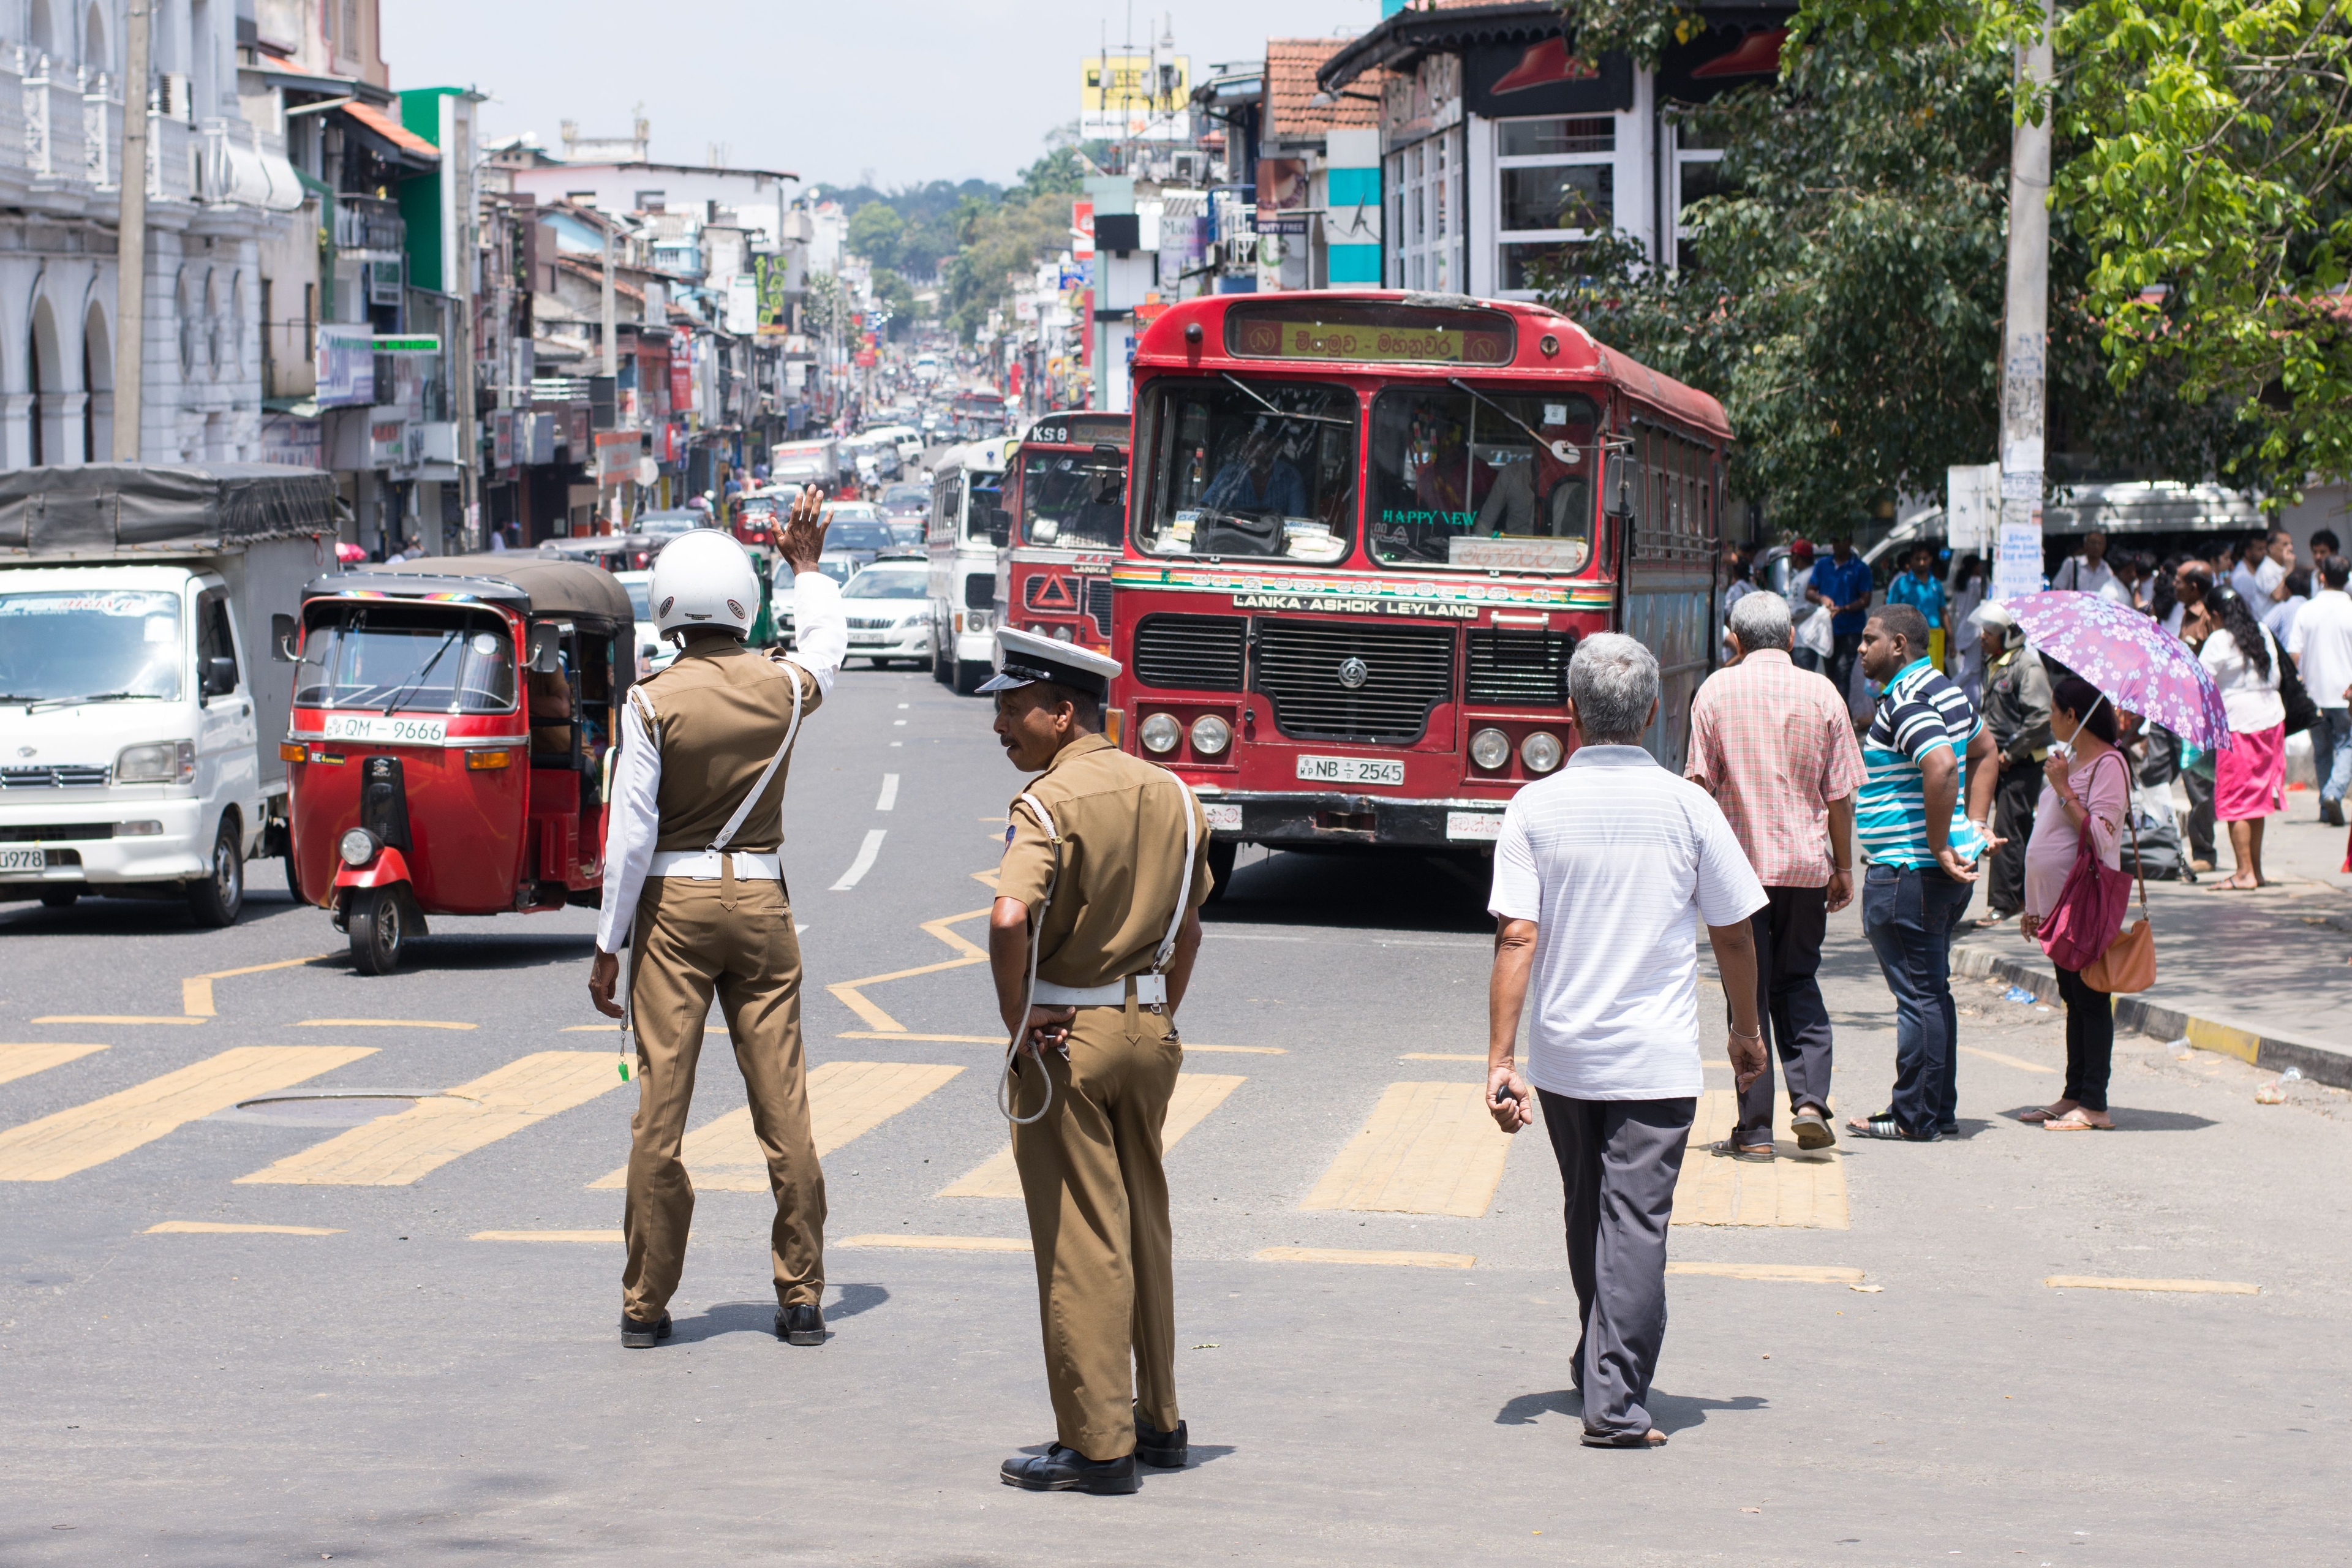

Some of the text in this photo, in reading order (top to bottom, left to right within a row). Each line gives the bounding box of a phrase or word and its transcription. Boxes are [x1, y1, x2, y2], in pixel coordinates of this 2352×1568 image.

[1257, 222, 1305, 233] DUTY FREE
[1378, 333, 1452, 358] මහනුවර
[1382, 510, 1438, 524] HAPPY
[1072, 565, 1107, 574] LANKA
[1233, 595, 1479, 618] LANKA ASHOK LEYLAND
[345, 719, 371, 737] QM
[394, 722, 441, 741] 9666
[1316, 761, 1338, 777] NB
[1359, 763, 1402, 782] 2545
[0, 851, 42, 868] 0978
